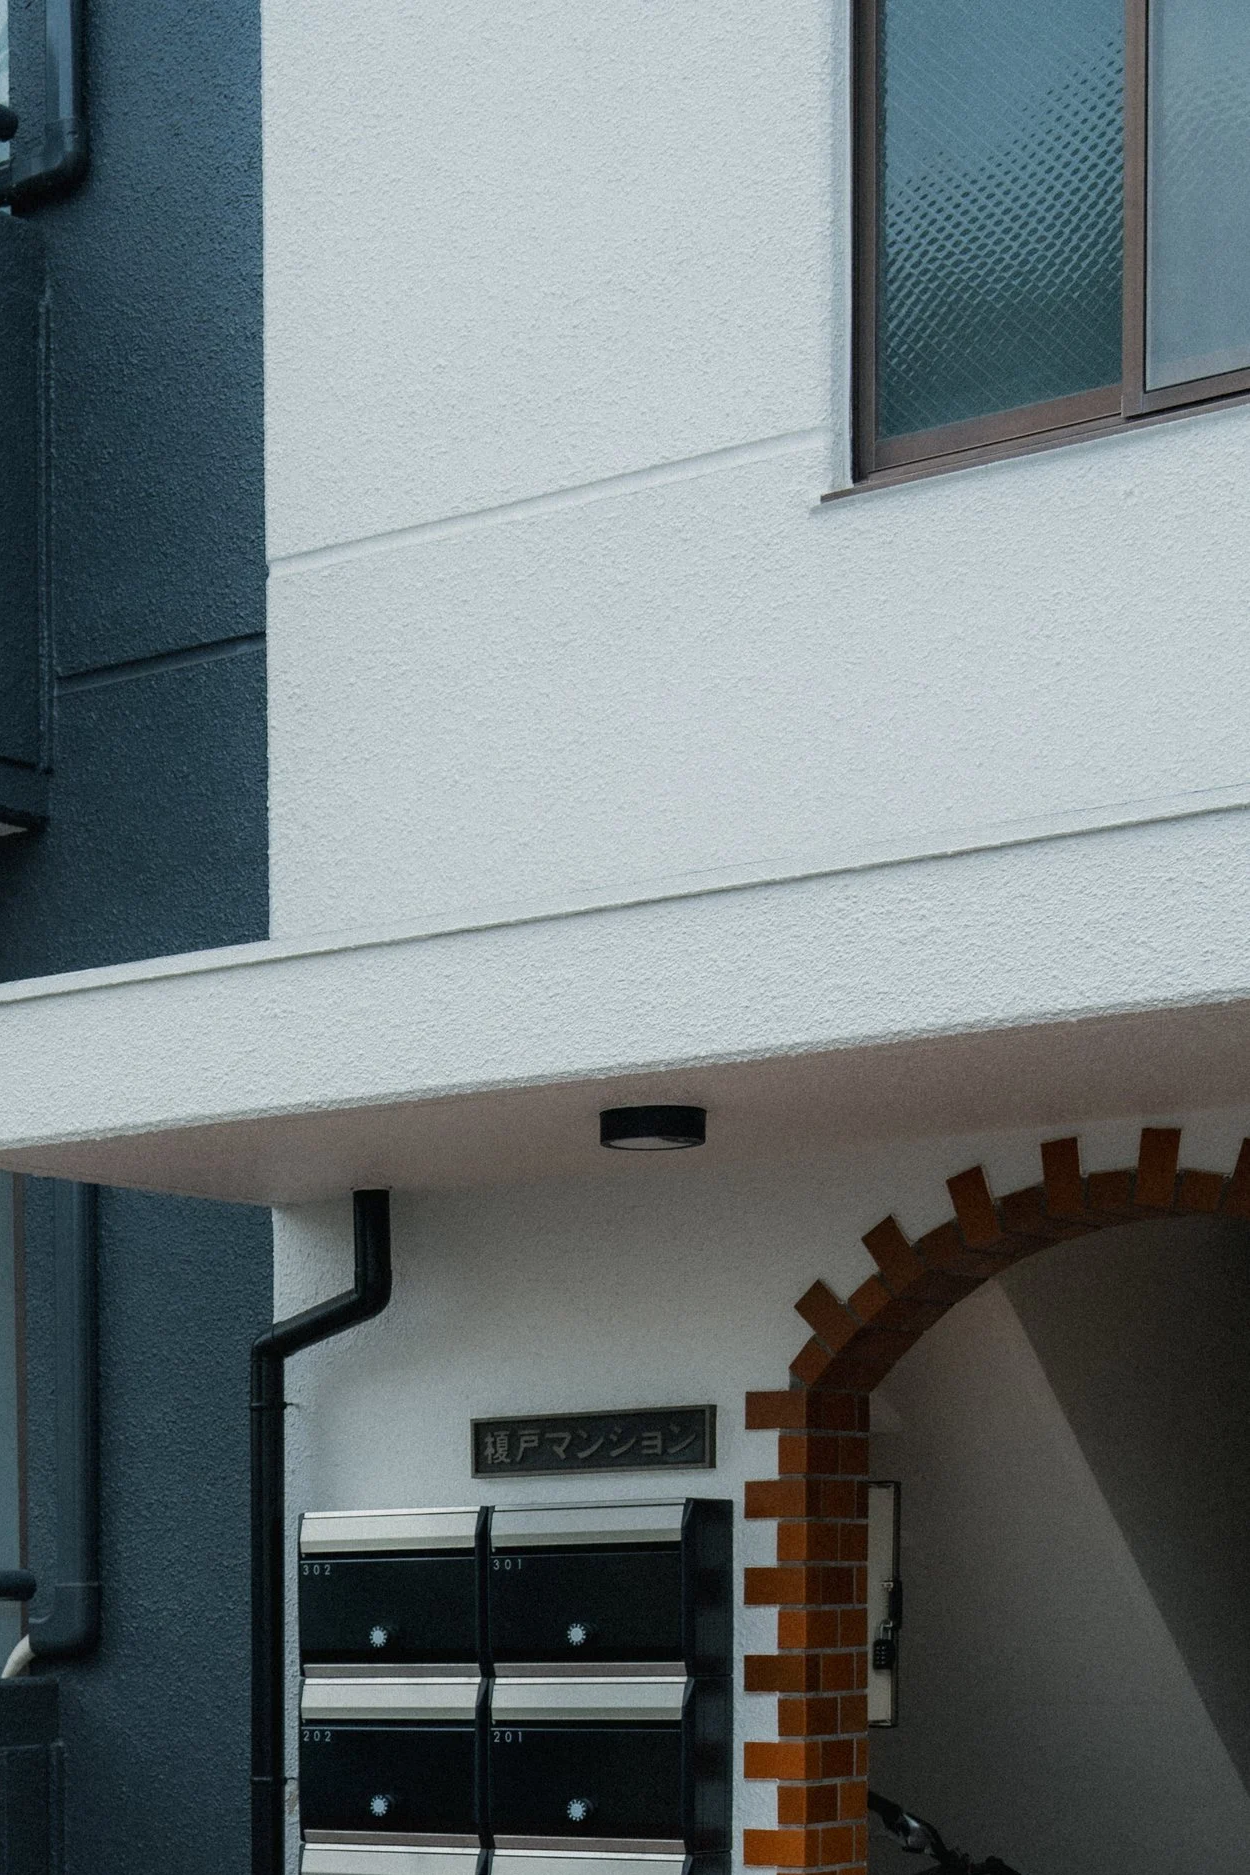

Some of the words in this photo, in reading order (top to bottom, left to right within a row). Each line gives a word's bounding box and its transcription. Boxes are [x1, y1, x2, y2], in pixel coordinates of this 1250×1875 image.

[483, 1422, 697, 1465] 榎戸マンション
[302, 1564, 331, 1576] 302
[493, 1558, 522, 1571] 301
[302, 1730, 332, 1742] 202
[493, 1731, 523, 1743] 201
